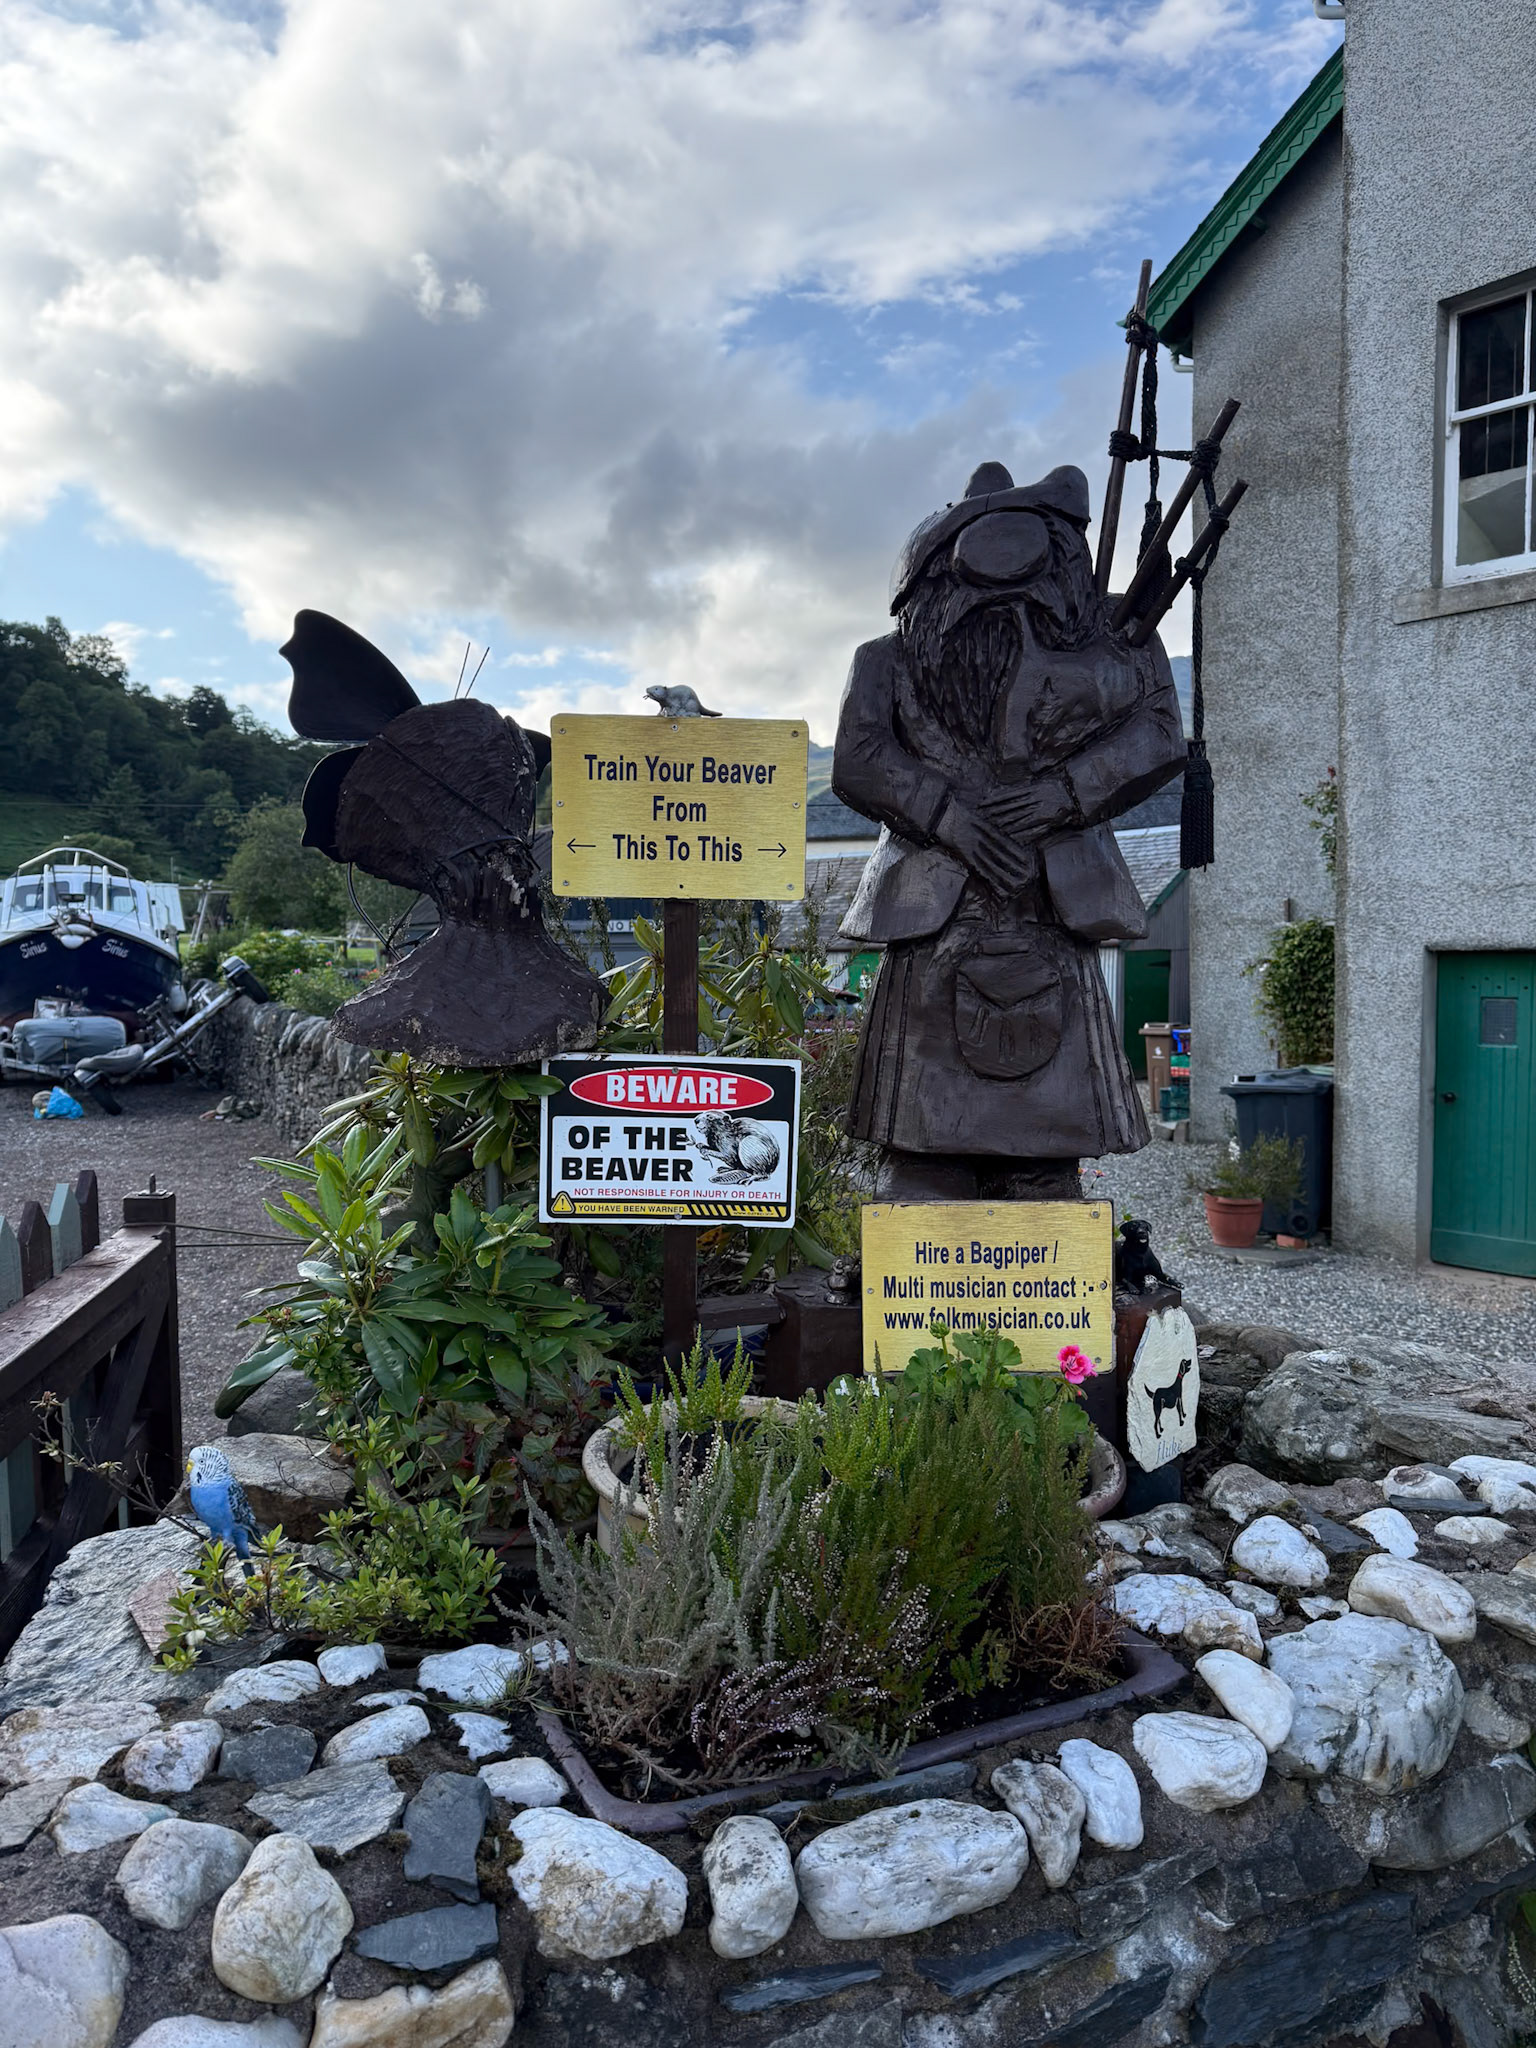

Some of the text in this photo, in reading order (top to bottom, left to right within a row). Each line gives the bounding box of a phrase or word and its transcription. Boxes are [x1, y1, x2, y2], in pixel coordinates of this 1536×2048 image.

[584, 754, 777, 785] Train Your Beaver
[652, 795, 707, 822] From
[612, 834, 743, 863] This To This
[19, 940, 48, 959] Sirius
[101, 938, 130, 959] Sirius
[606, 1074, 738, 1105] BEWARE
[568, 1125, 688, 1151] OF THE
[561, 1157, 693, 1182] BEAVER
[574, 1187, 782, 1200] NOT RESPONSIBLE FOR INJURY OR DEATH
[578, 1204, 686, 1214] YOU HAVE BEEN WARNED
[915, 1241, 950, 1264] Hire
[955, 1246, 965, 1264] a
[970, 1241, 1048, 1270] Bagpiper
[883, 1276, 924, 1299] Multi
[930, 1276, 1006, 1299] musician
[1012, 1276, 1077, 1298] contact
[883, 1306, 1091, 1329] www.folkmusician.co.uk
